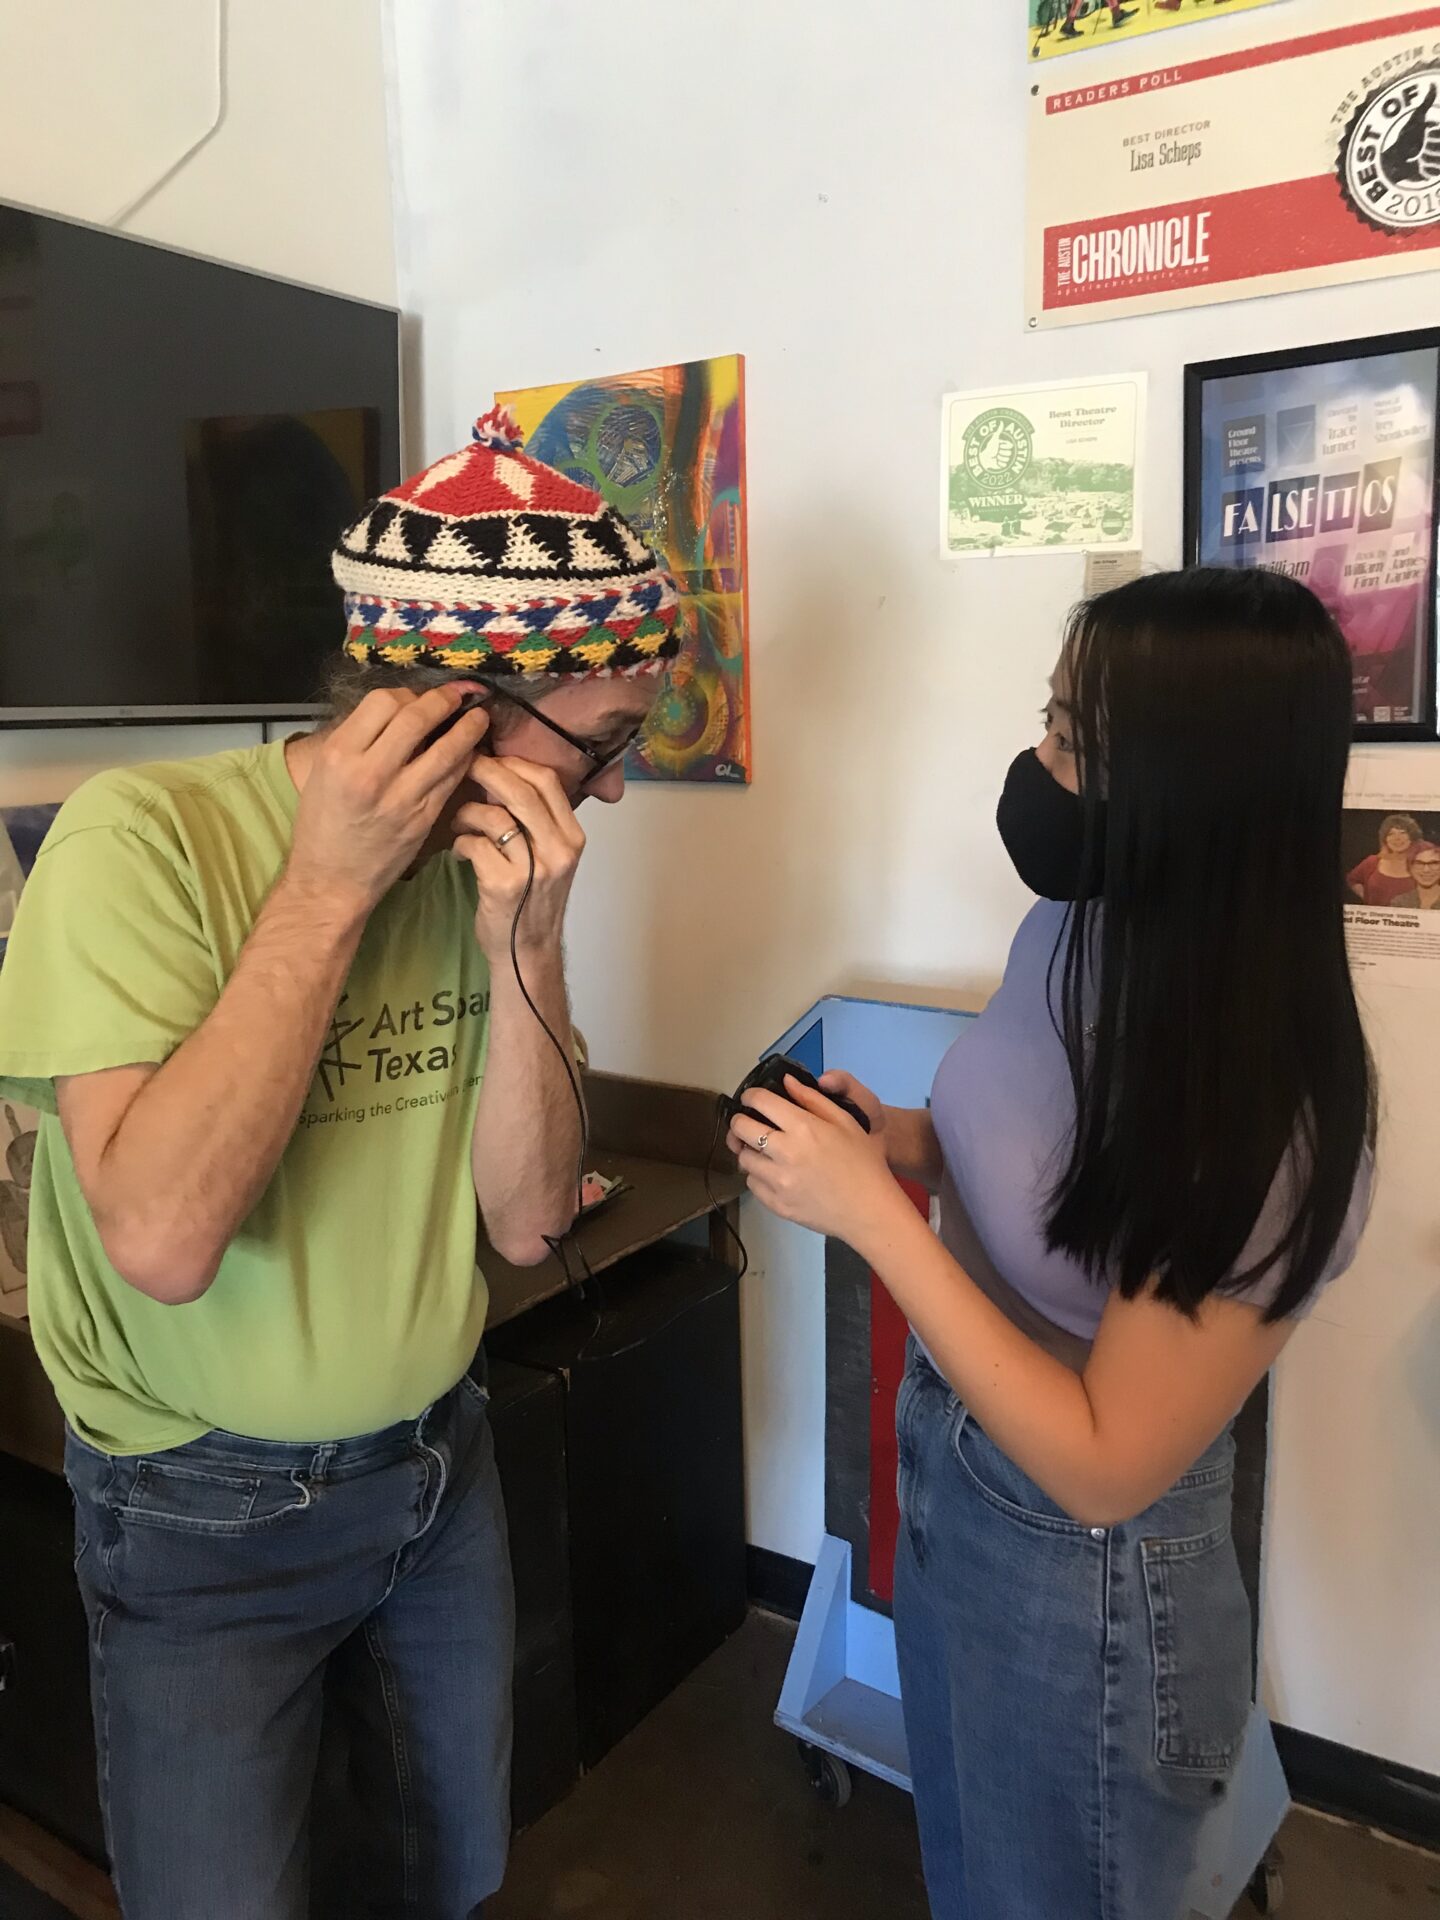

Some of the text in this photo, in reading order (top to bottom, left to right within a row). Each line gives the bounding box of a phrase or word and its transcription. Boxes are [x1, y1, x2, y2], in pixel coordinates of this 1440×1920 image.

[1361, 46, 1424, 89] AUSTIN
[1053, 70, 1182, 110] READERS POLL
[1122, 120, 1211, 147] BEST DIRECTOR
[1356, 83, 1419, 204] BEST OF
[1130, 141, 1202, 172] Lisa Scheps
[1072, 211, 1212, 284] CHRONICLE
[1057, 237, 1071, 286] THE AUSTIN
[1049, 406, 1117, 419] Best Theatre
[1060, 418, 1105, 428] Director
[1228, 426, 1256, 438] Ground
[1228, 438, 1248, 448] Floor
[968, 437, 983, 477] BEST
[979, 420, 997, 437] OF
[1004, 422, 1028, 475] AUSTIN
[1229, 456, 1261, 467] presents
[981, 472, 1013, 486] 2022
[968, 494, 1024, 508] WINNER
[1382, 919, 1420, 928] Theatre
[368, 1001, 425, 1039] Art
[298, 1108, 366, 1129] Sparking
[370, 1102, 392, 1117] the
